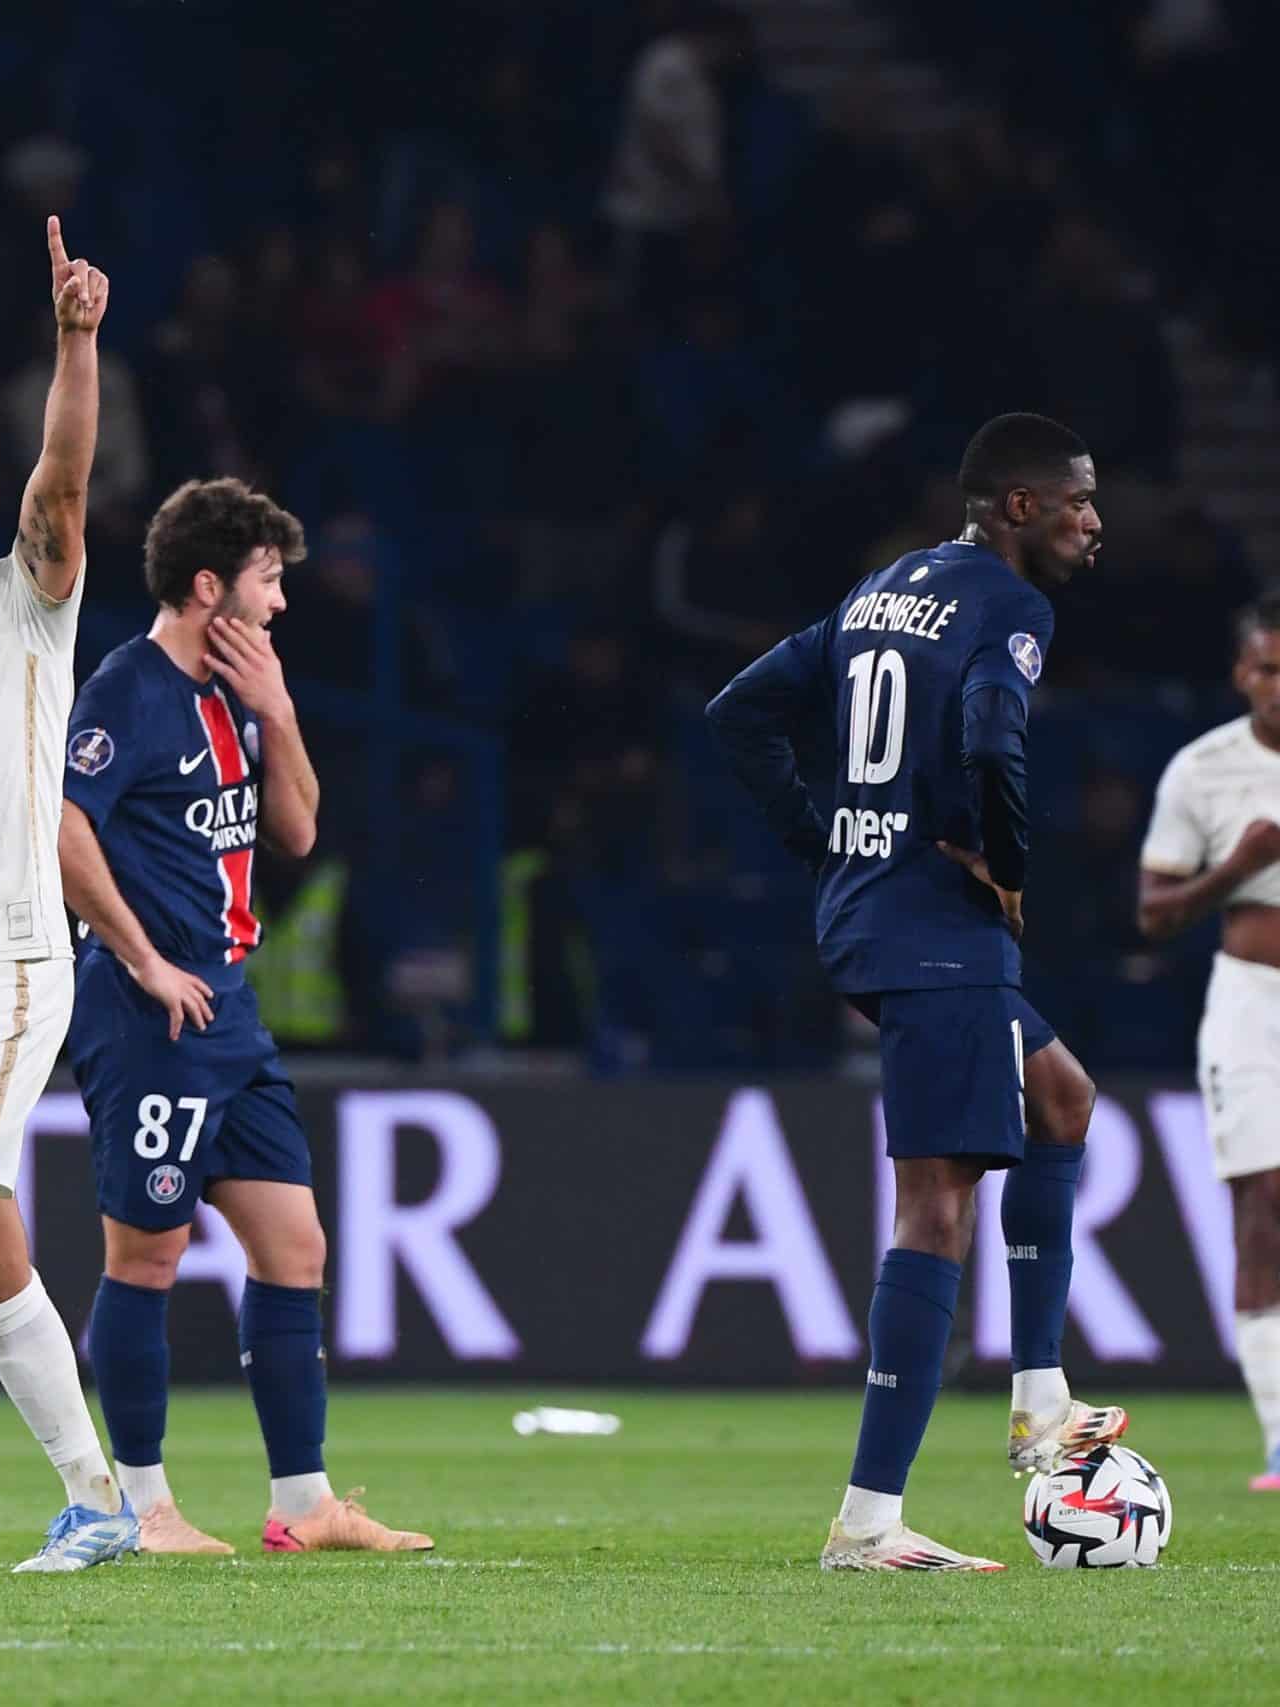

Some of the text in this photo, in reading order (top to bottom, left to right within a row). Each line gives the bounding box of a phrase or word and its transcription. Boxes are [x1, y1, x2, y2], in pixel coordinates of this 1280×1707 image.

[847, 650, 907, 784] 10
[211, 821, 257, 851] AIRW
[133, 1093, 208, 1162] 87
[638, 1086, 1238, 1362] AR
